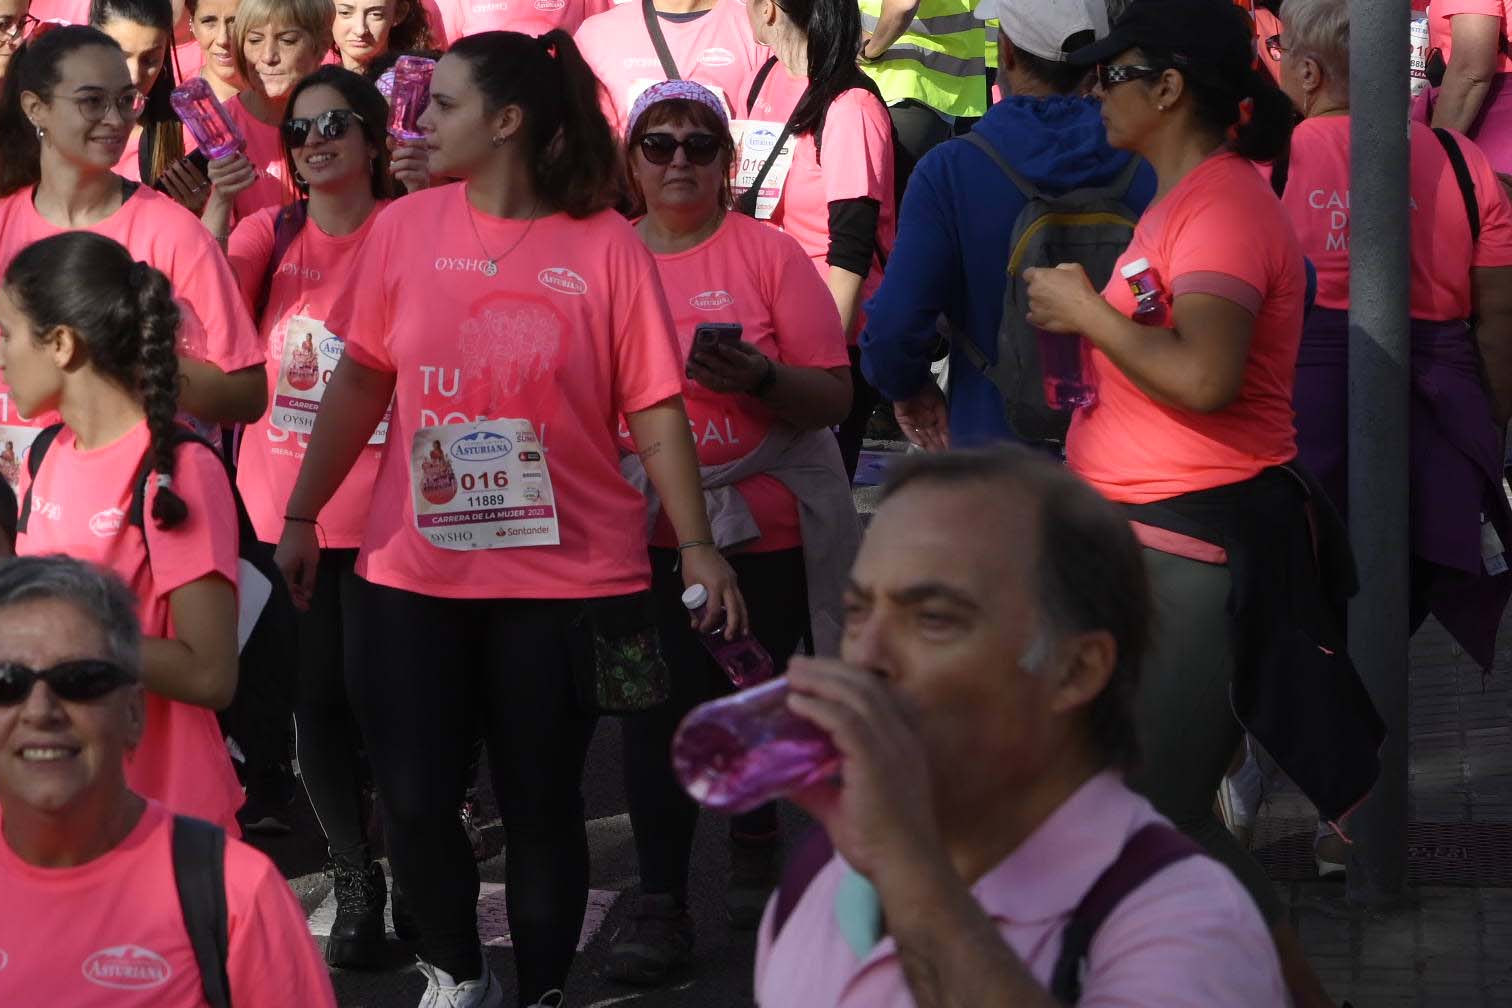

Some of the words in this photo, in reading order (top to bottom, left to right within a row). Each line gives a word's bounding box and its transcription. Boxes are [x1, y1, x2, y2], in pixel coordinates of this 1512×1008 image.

[742, 158, 766, 171] 016
[419, 365, 461, 397] TU
[289, 400, 318, 411] CARRER
[283, 414, 313, 428] OYSH
[456, 444, 508, 456] ASTURIANA
[460, 470, 509, 490] 016
[467, 494, 505, 507] 11889
[432, 514, 471, 524] CARRERA
[472, 513, 483, 521] DE
[484, 512, 496, 520] LA
[497, 510, 524, 518] MUJER
[527, 508, 545, 516] 2023
[430, 530, 473, 543] OYSHO
[508, 526, 549, 537] Santander
